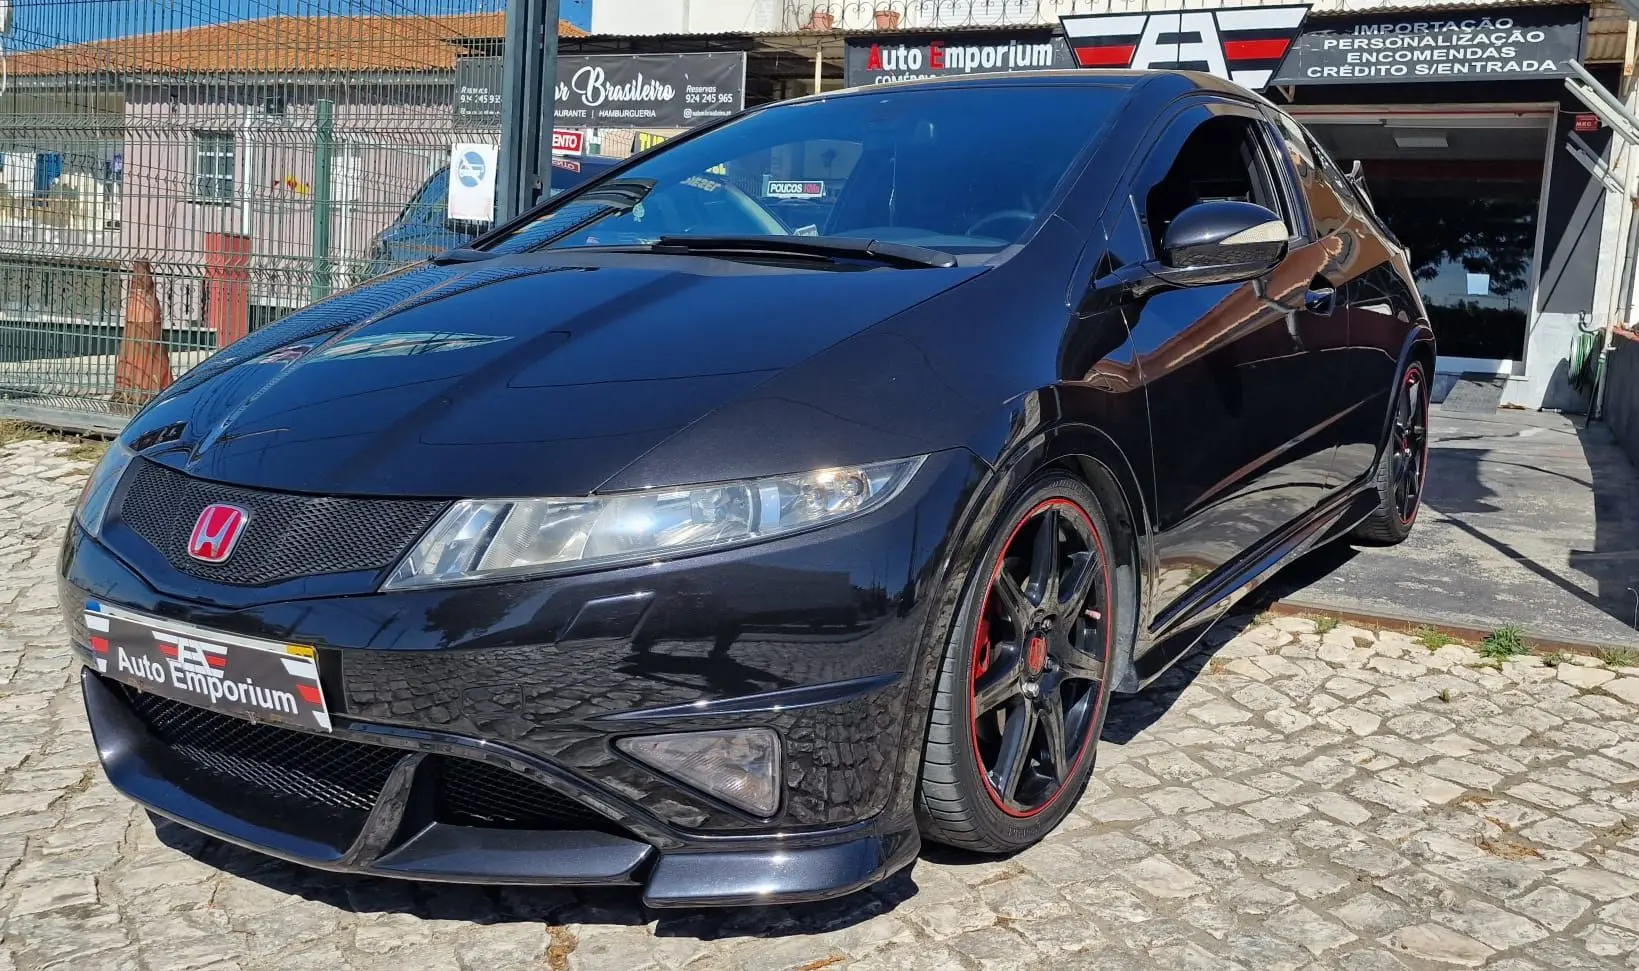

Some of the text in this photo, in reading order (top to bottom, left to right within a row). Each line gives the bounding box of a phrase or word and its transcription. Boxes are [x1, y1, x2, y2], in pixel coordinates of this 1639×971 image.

[1354, 17, 1513, 36] IMPORTAÇÃO
[1323, 30, 1546, 50] PERSONALIZAÇÃO
[867, 40, 1053, 72] Auto Emporium
[1346, 47, 1516, 63] ENCOMENDAS
[1307, 59, 1558, 78] CRÉDITO S/ENTRADA
[571, 66, 676, 107] Brasileiro
[686, 85, 717, 93] Reservas
[685, 93, 733, 103] 924 245 965
[554, 109, 656, 118] AURANTE HAMBURGUERIA
[552, 135, 577, 149] ENTO
[770, 183, 802, 193] POUCOS
[117, 647, 299, 714] Auto Emporium
